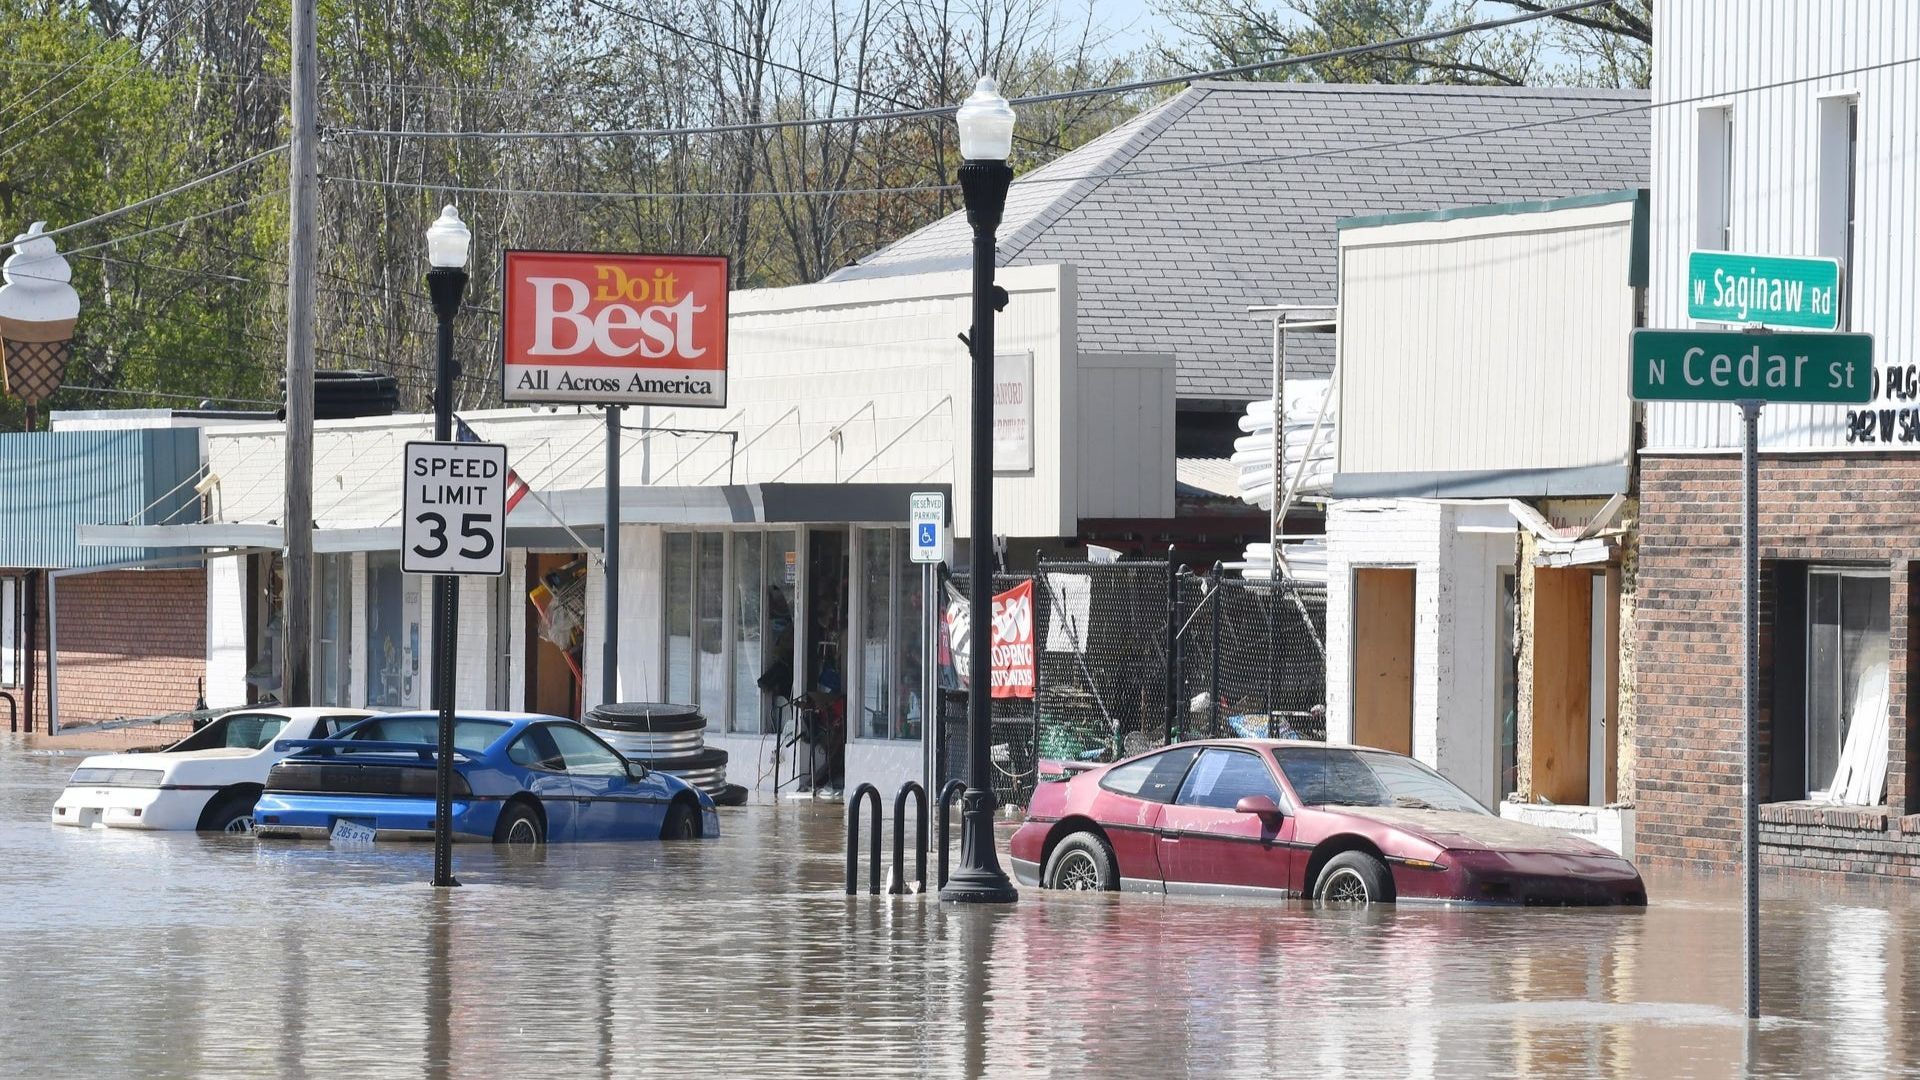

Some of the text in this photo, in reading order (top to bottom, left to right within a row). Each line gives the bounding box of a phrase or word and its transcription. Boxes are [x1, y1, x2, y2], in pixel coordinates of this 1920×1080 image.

[594, 265, 680, 304] Do it
[1694, 267, 1831, 320] W Saginaw Rd
[526, 276, 707, 360] Best
[1649, 358, 1665, 385] N
[1682, 345, 1809, 388] Cedar
[1828, 361, 1855, 389] St
[517, 370, 712, 395] All Across America
[994, 381, 1024, 406] ANFORD
[1886, 364, 1920, 401] PLG
[1846, 409, 1877, 443] 342
[1879, 409, 1896, 443] W
[413, 457, 498, 479] SPEED
[422, 485, 488, 505] LIMIT
[912, 499, 942, 509] RESERVED
[914, 511, 941, 521] PARKING
[412, 511, 495, 560] 35
[336, 826, 352, 838] 285
